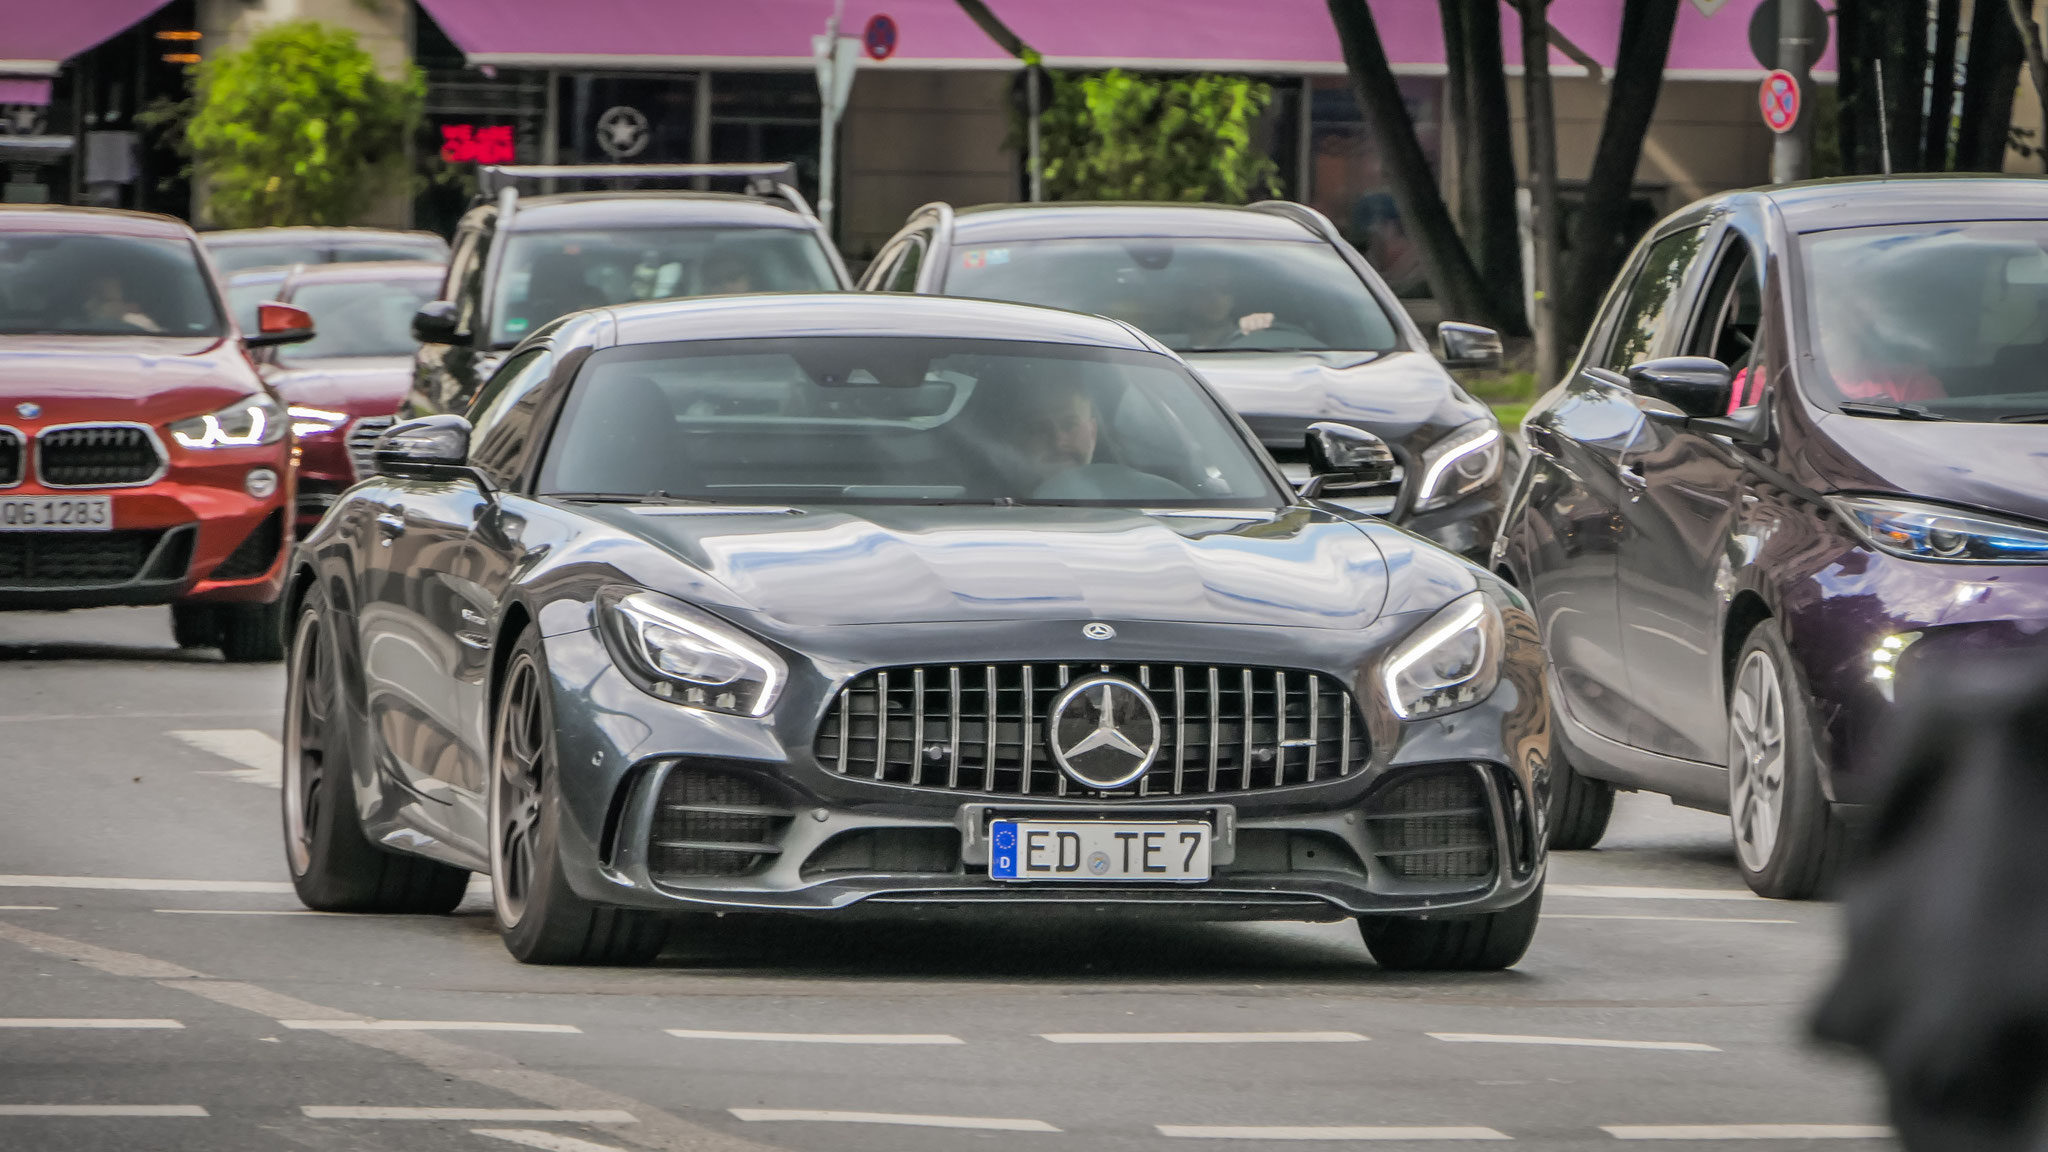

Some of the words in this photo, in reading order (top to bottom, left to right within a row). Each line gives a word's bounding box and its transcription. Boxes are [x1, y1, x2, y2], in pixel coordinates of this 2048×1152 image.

[43, 501, 105, 525] 1283
[1000, 856, 1011, 869] D
[1026, 831, 1081, 872] ED
[1114, 832, 1167, 873] TE
[1179, 832, 1202, 873] 7
